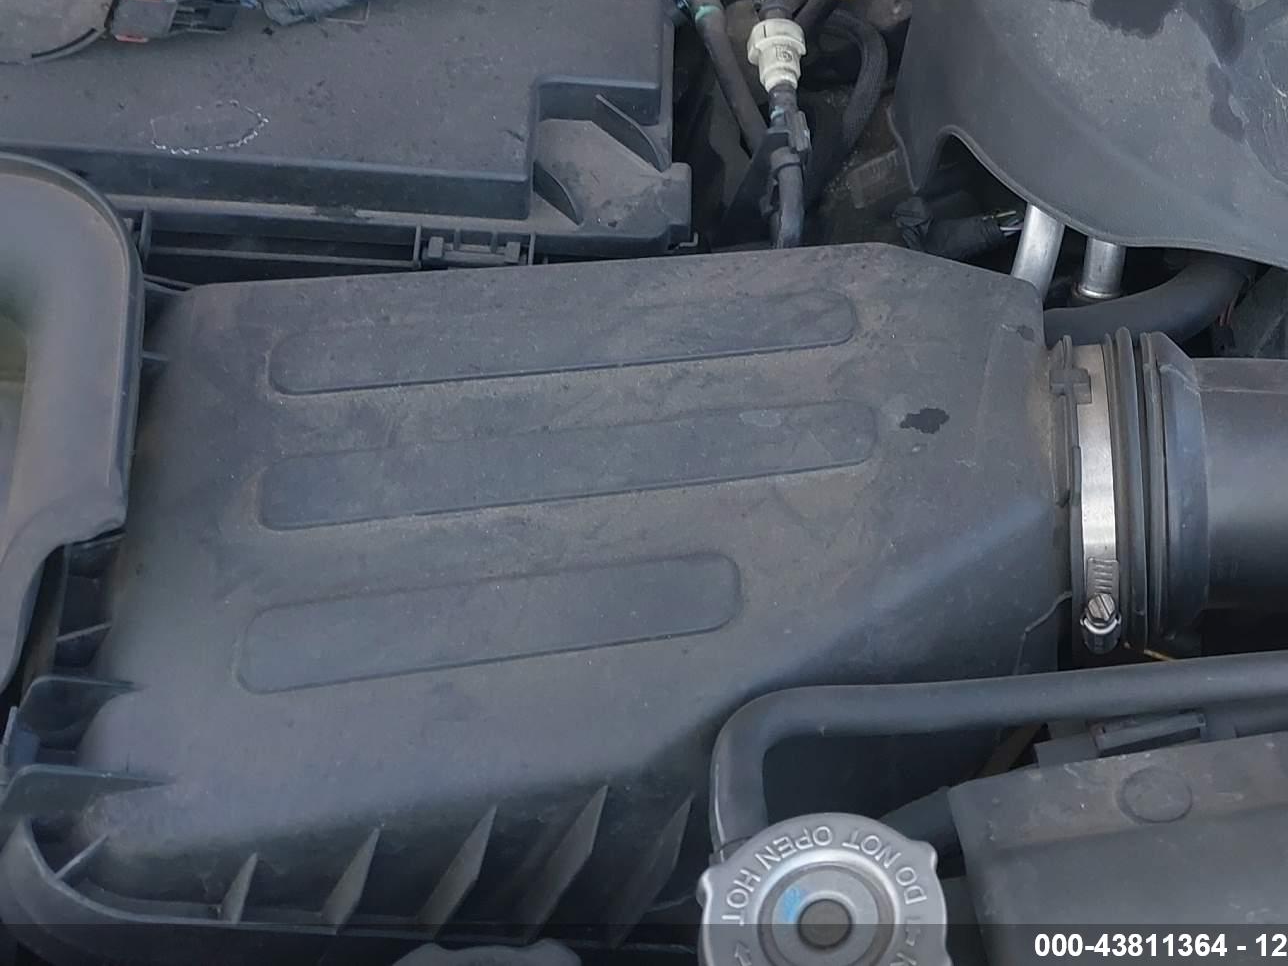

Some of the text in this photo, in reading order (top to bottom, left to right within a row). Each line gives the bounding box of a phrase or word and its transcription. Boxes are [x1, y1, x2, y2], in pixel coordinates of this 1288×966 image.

[721, 825, 928, 927] DO NOT OPEN HOT
